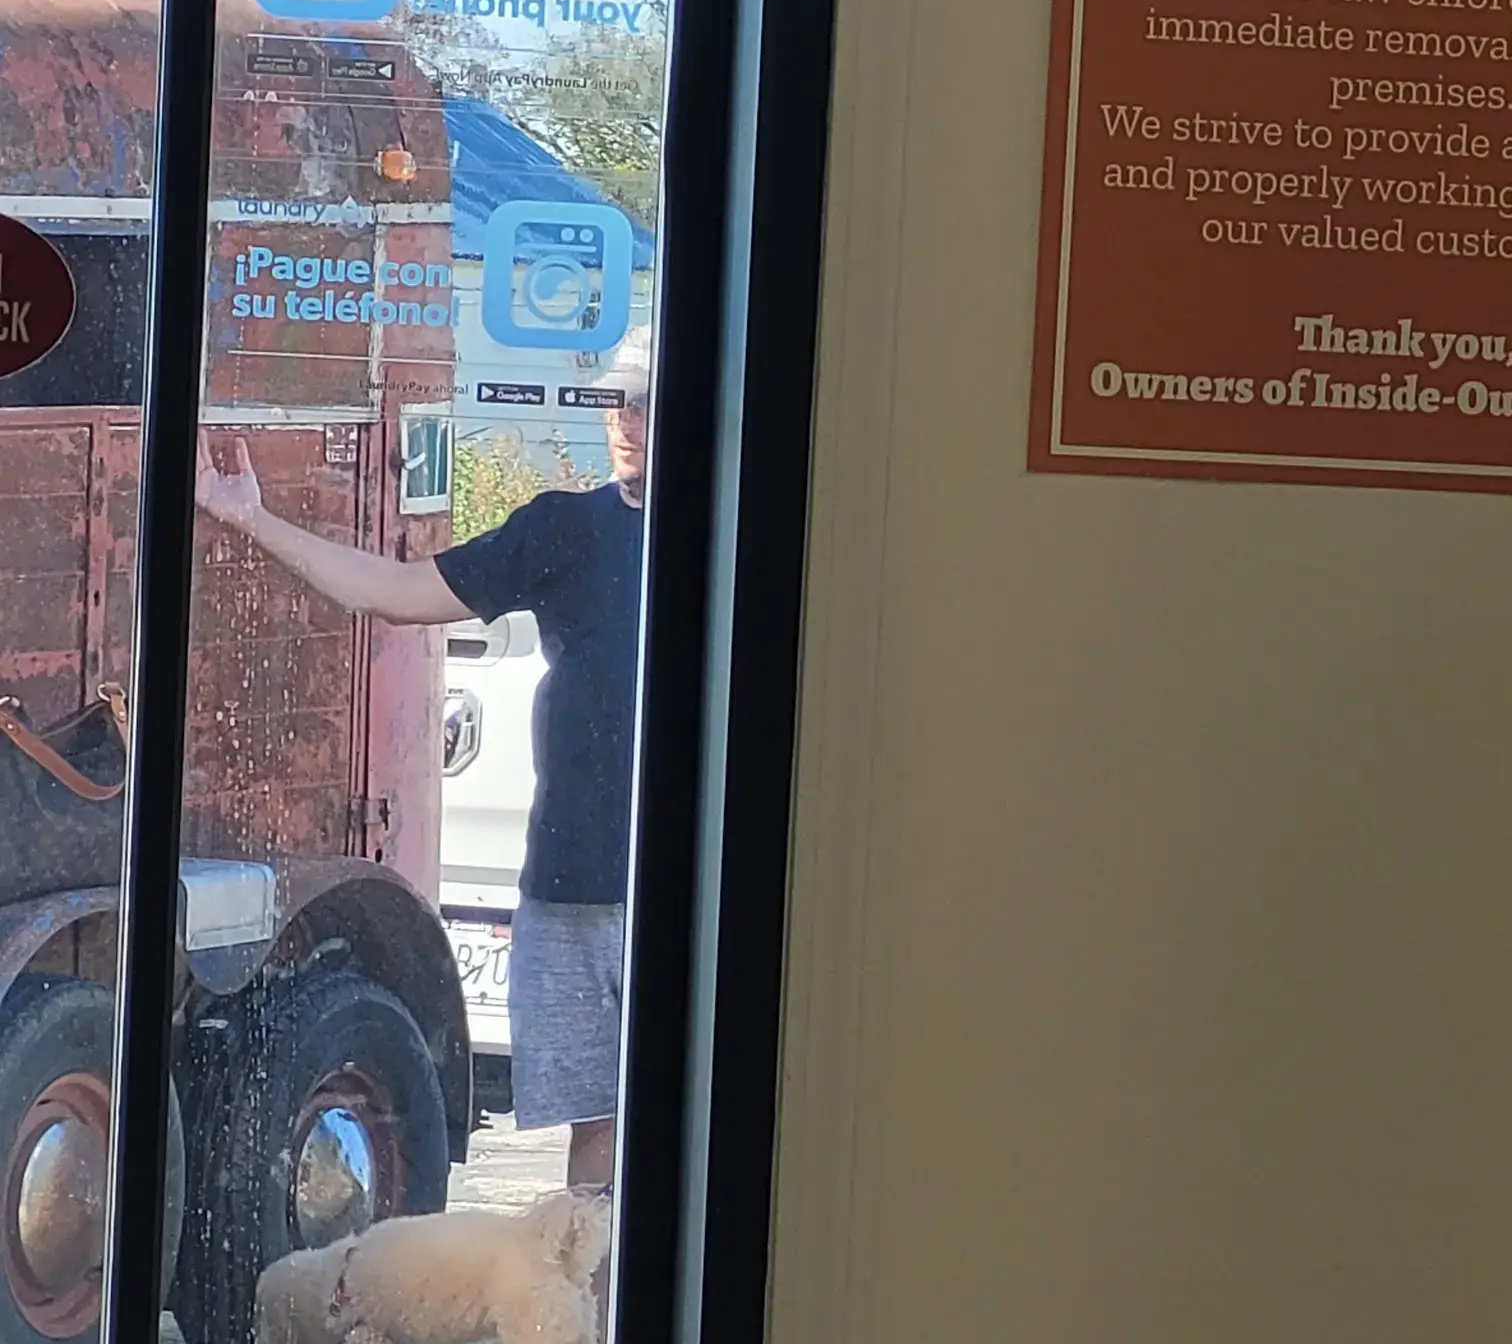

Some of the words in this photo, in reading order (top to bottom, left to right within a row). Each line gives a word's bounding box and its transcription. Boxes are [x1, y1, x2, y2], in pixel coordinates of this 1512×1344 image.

[1146, 8, 1353, 50] immediate
[1330, 75, 1512, 109] premises.
[1101, 105, 1160, 139] We
[1173, 112, 1282, 145] strive
[1295, 119, 1332, 148] to
[1343, 124, 1489, 159] provide
[1104, 156, 1174, 189] and
[1186, 165, 1352, 208] properly
[1203, 220, 1267, 244] our
[1278, 215, 1404, 252] valued
[235, 246, 371, 288] ¡Pague
[379, 261, 450, 288] con
[231, 293, 276, 319] su
[284, 290, 461, 327] teléfono!
[1295, 314, 1425, 357] Thank
[1091, 363, 1254, 403] Owners
[1263, 368, 1311, 406] of
